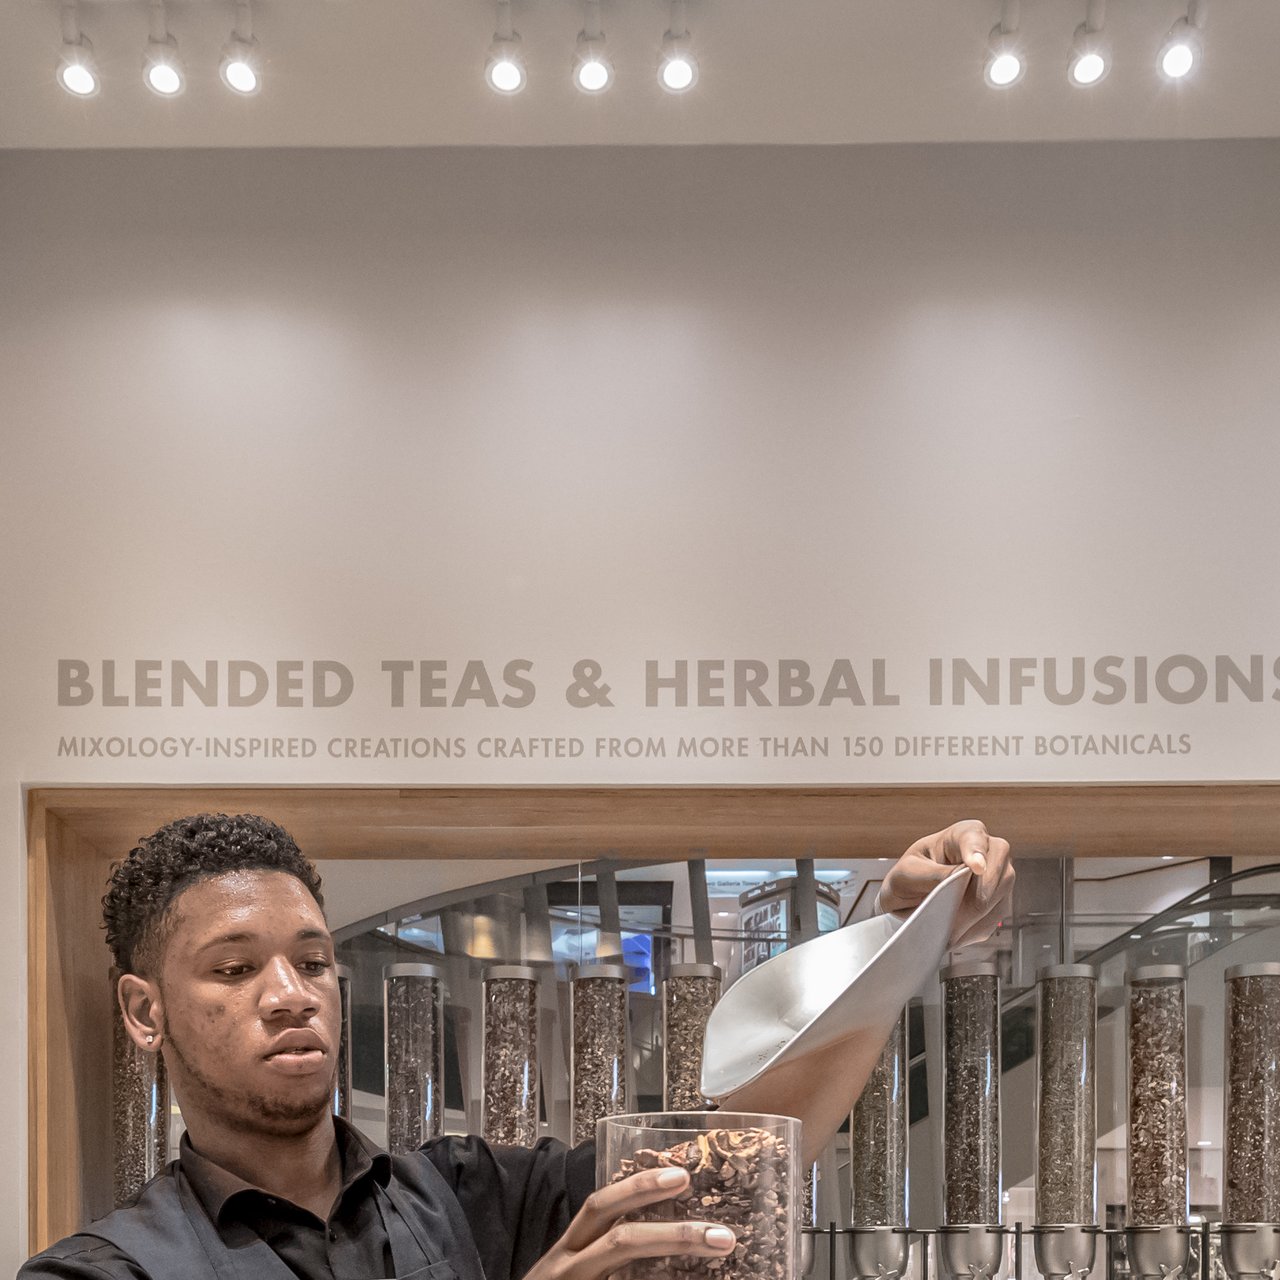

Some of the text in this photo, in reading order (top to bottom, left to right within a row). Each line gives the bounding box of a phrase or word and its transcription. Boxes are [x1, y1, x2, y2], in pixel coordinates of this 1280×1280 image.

[58, 660, 355, 708] BLENDED
[382, 660, 537, 709] TEAS
[567, 660, 616, 709] &
[646, 660, 901, 708] HERBAL
[57, 735, 1192, 759] MIXOLOGY-INSPIRED CREATIONS CRAFTED FROM MORE THAN 150 DIFFERENT BOTANICALS
